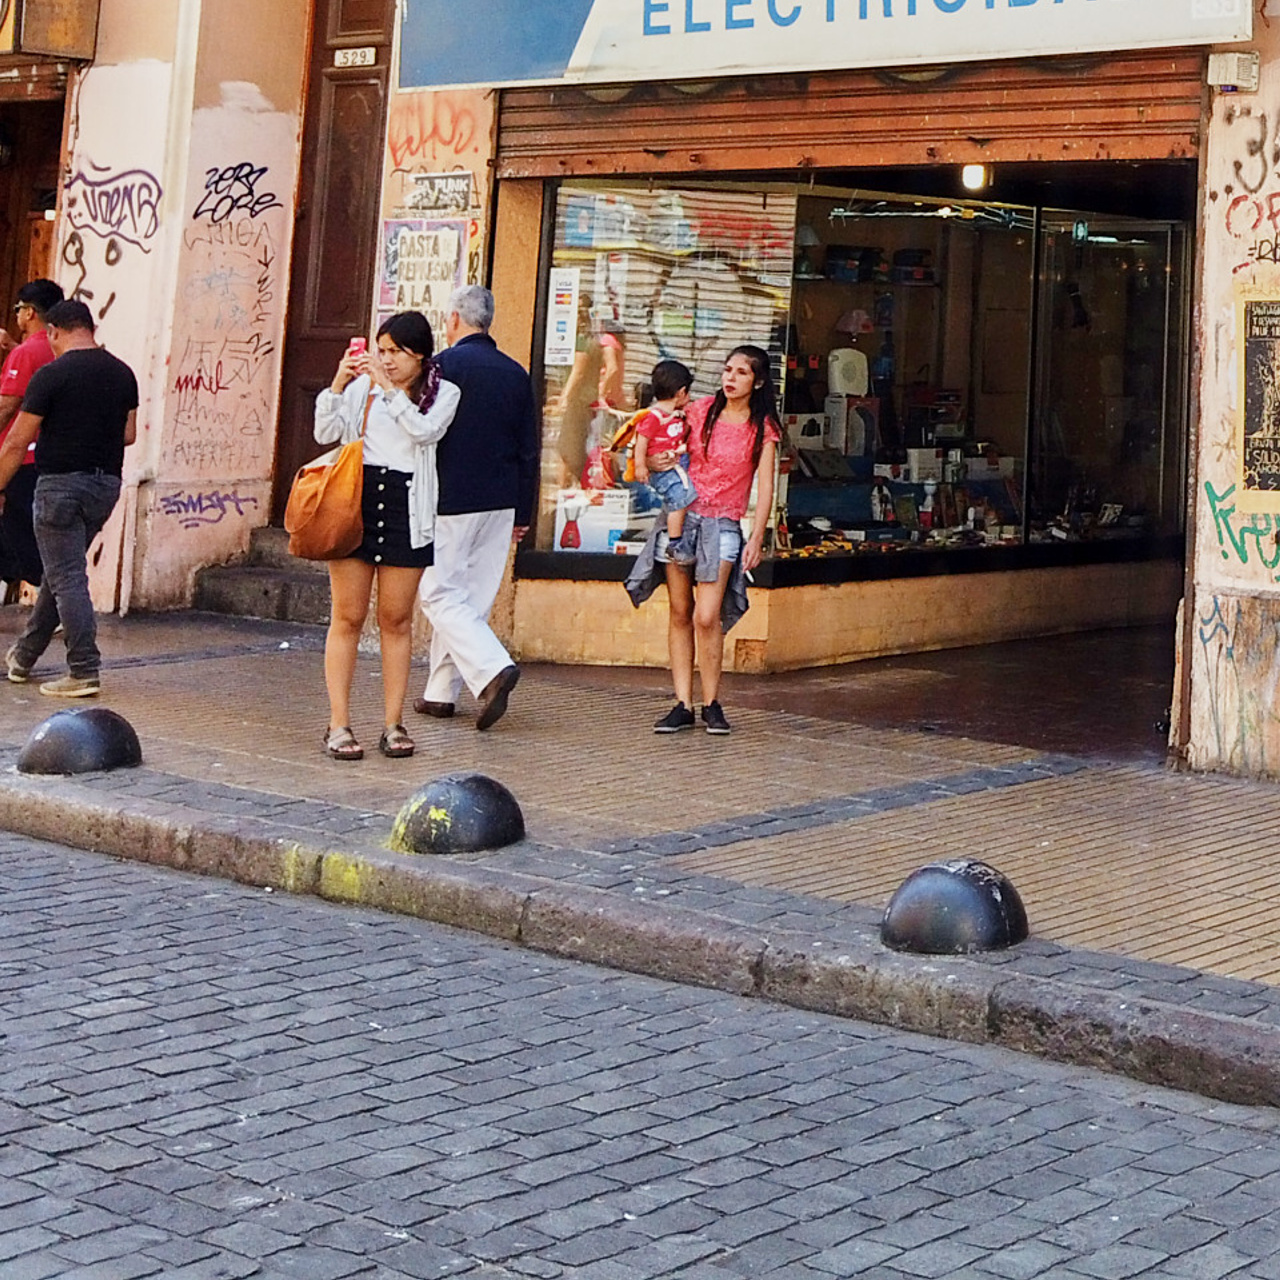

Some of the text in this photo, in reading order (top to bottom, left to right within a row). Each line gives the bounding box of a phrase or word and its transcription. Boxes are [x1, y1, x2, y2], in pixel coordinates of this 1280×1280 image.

[341, 49, 369, 65] 529
[399, 234, 440, 259] BASTA
[411, 284, 432, 307] LA
